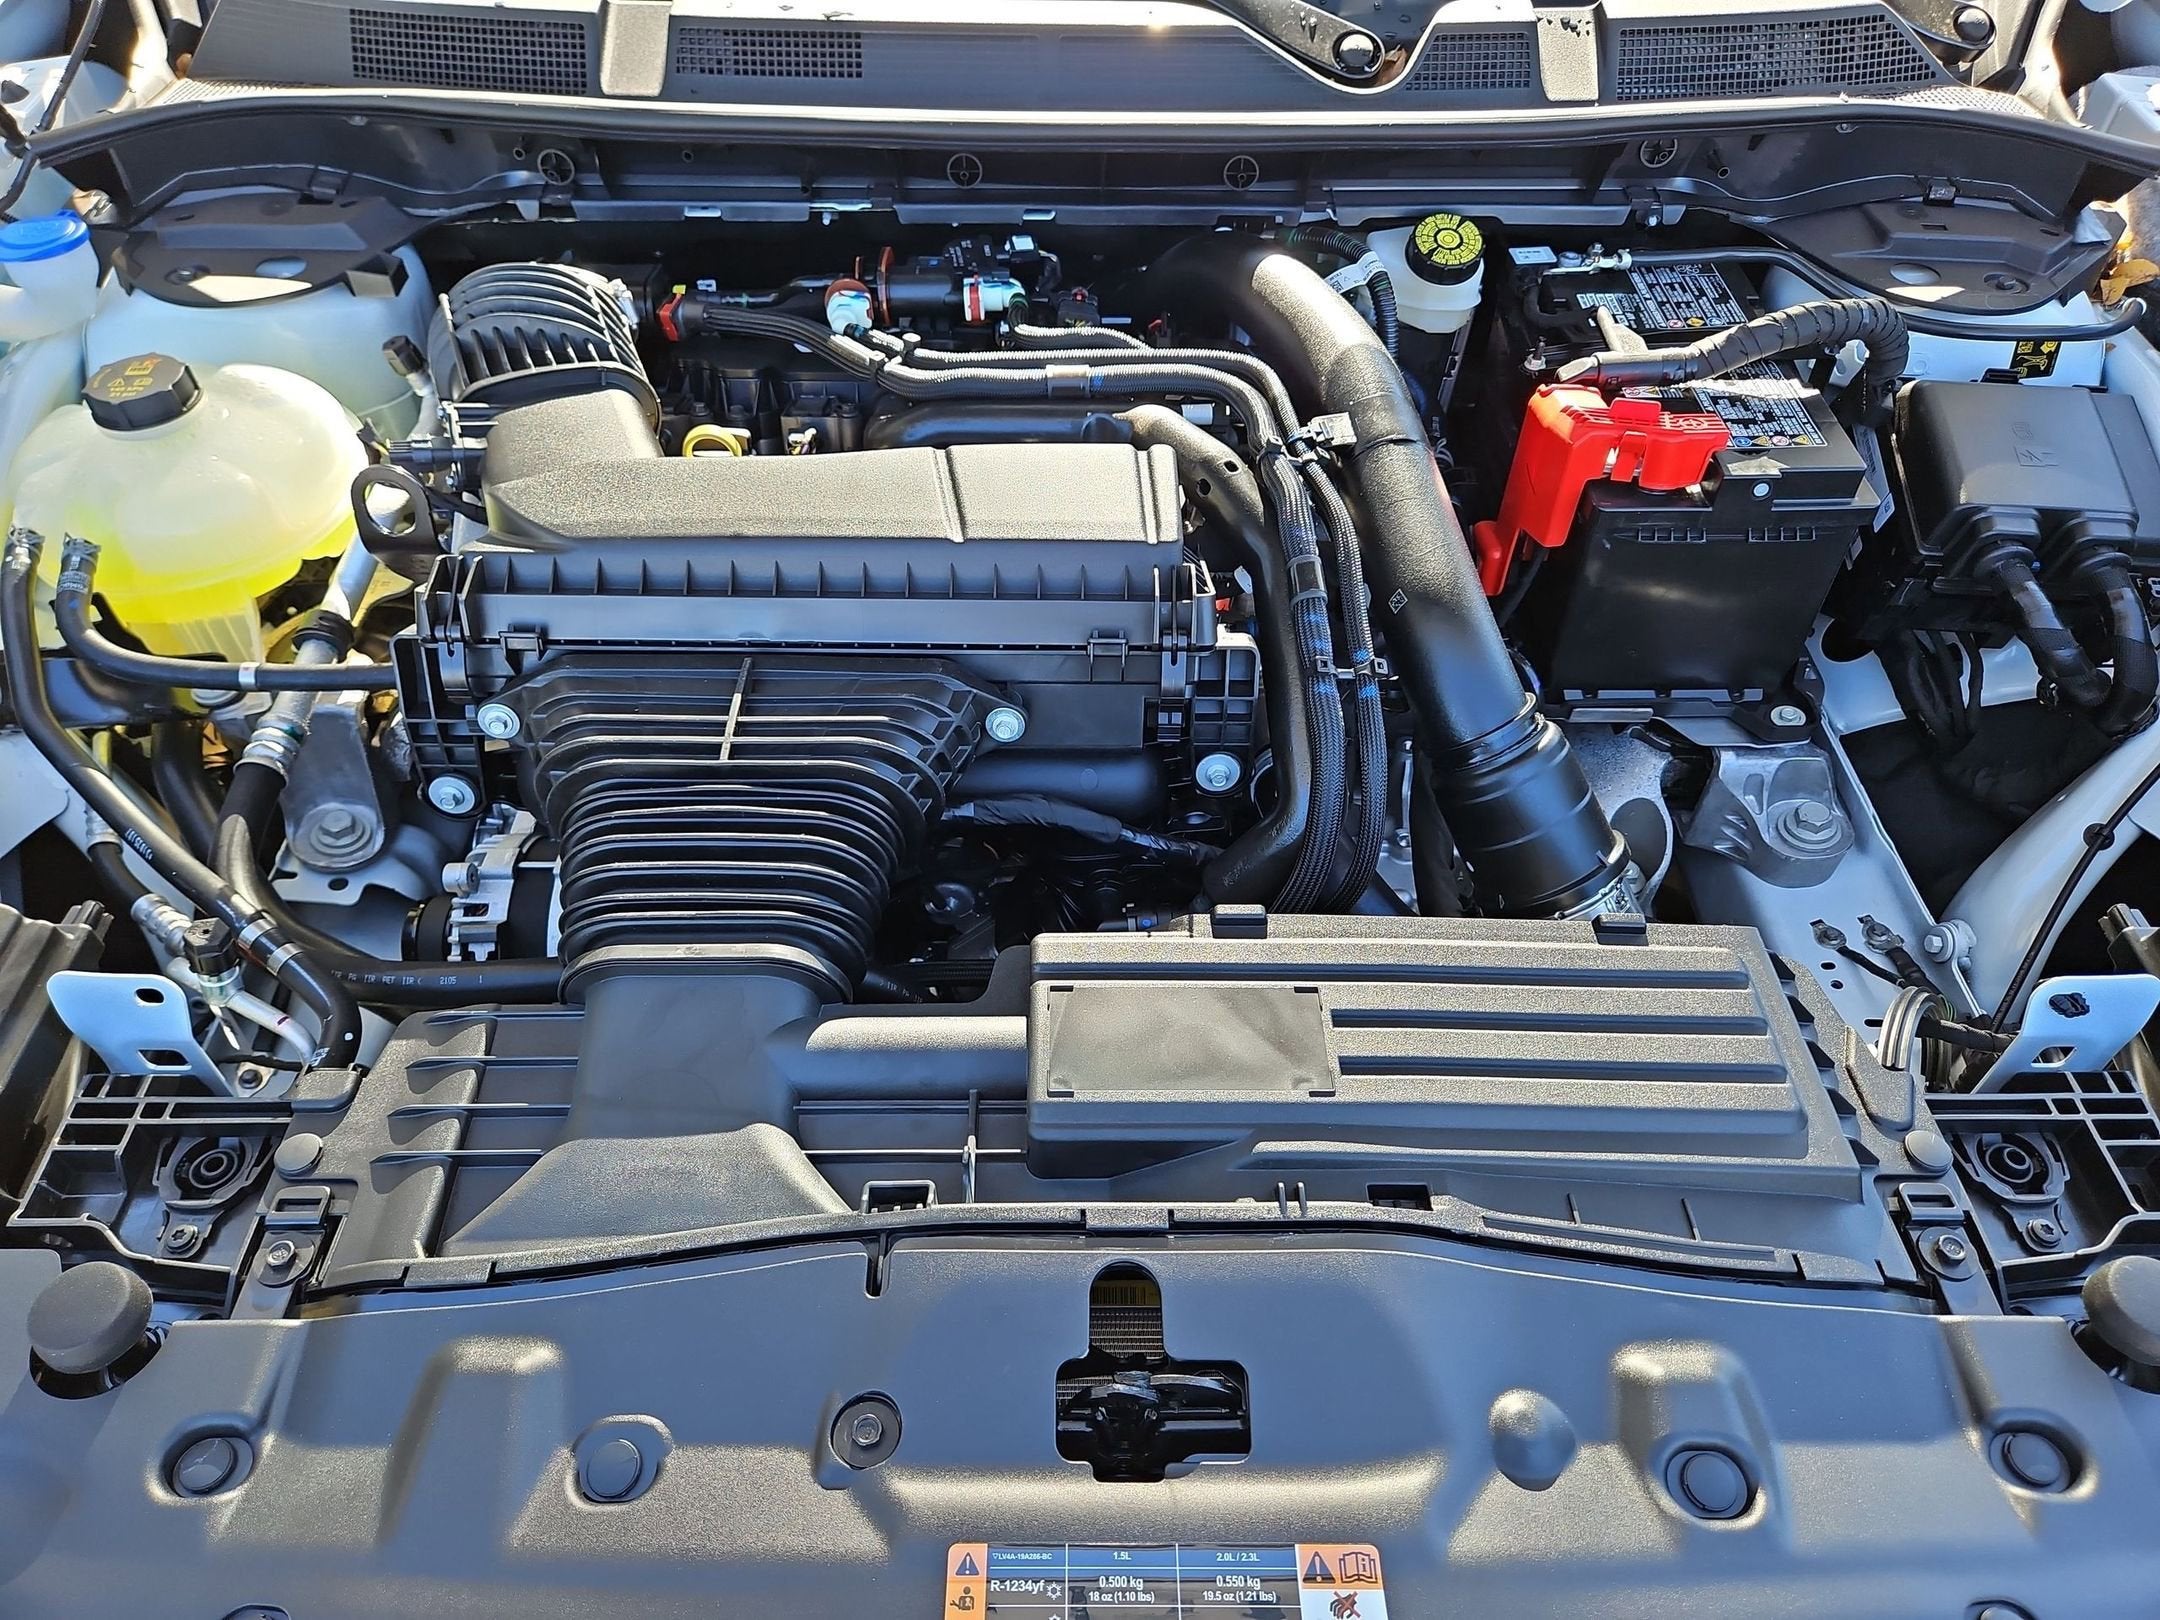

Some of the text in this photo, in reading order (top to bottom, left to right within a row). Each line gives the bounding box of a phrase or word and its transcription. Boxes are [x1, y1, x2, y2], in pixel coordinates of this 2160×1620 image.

[439, 975, 457, 985] 2105
[1113, 1552, 1132, 1560] 1.5L
[1216, 1552, 1235, 1561] 2.0L
[1241, 1552, 1260, 1561] 2.3L
[990, 1579, 1045, 1594] R-1234yf
[1099, 1575, 1144, 1590] 0.500 kg
[1216, 1575, 1261, 1590] 0.550 kg
[1089, 1592, 1100, 1601] 18
[1114, 1591, 1136, 1603] (1.10
[1138, 1591, 1155, 1603] lbs)
[1202, 1591, 1277, 1603] 19.5 oz (1.21 lbs)
